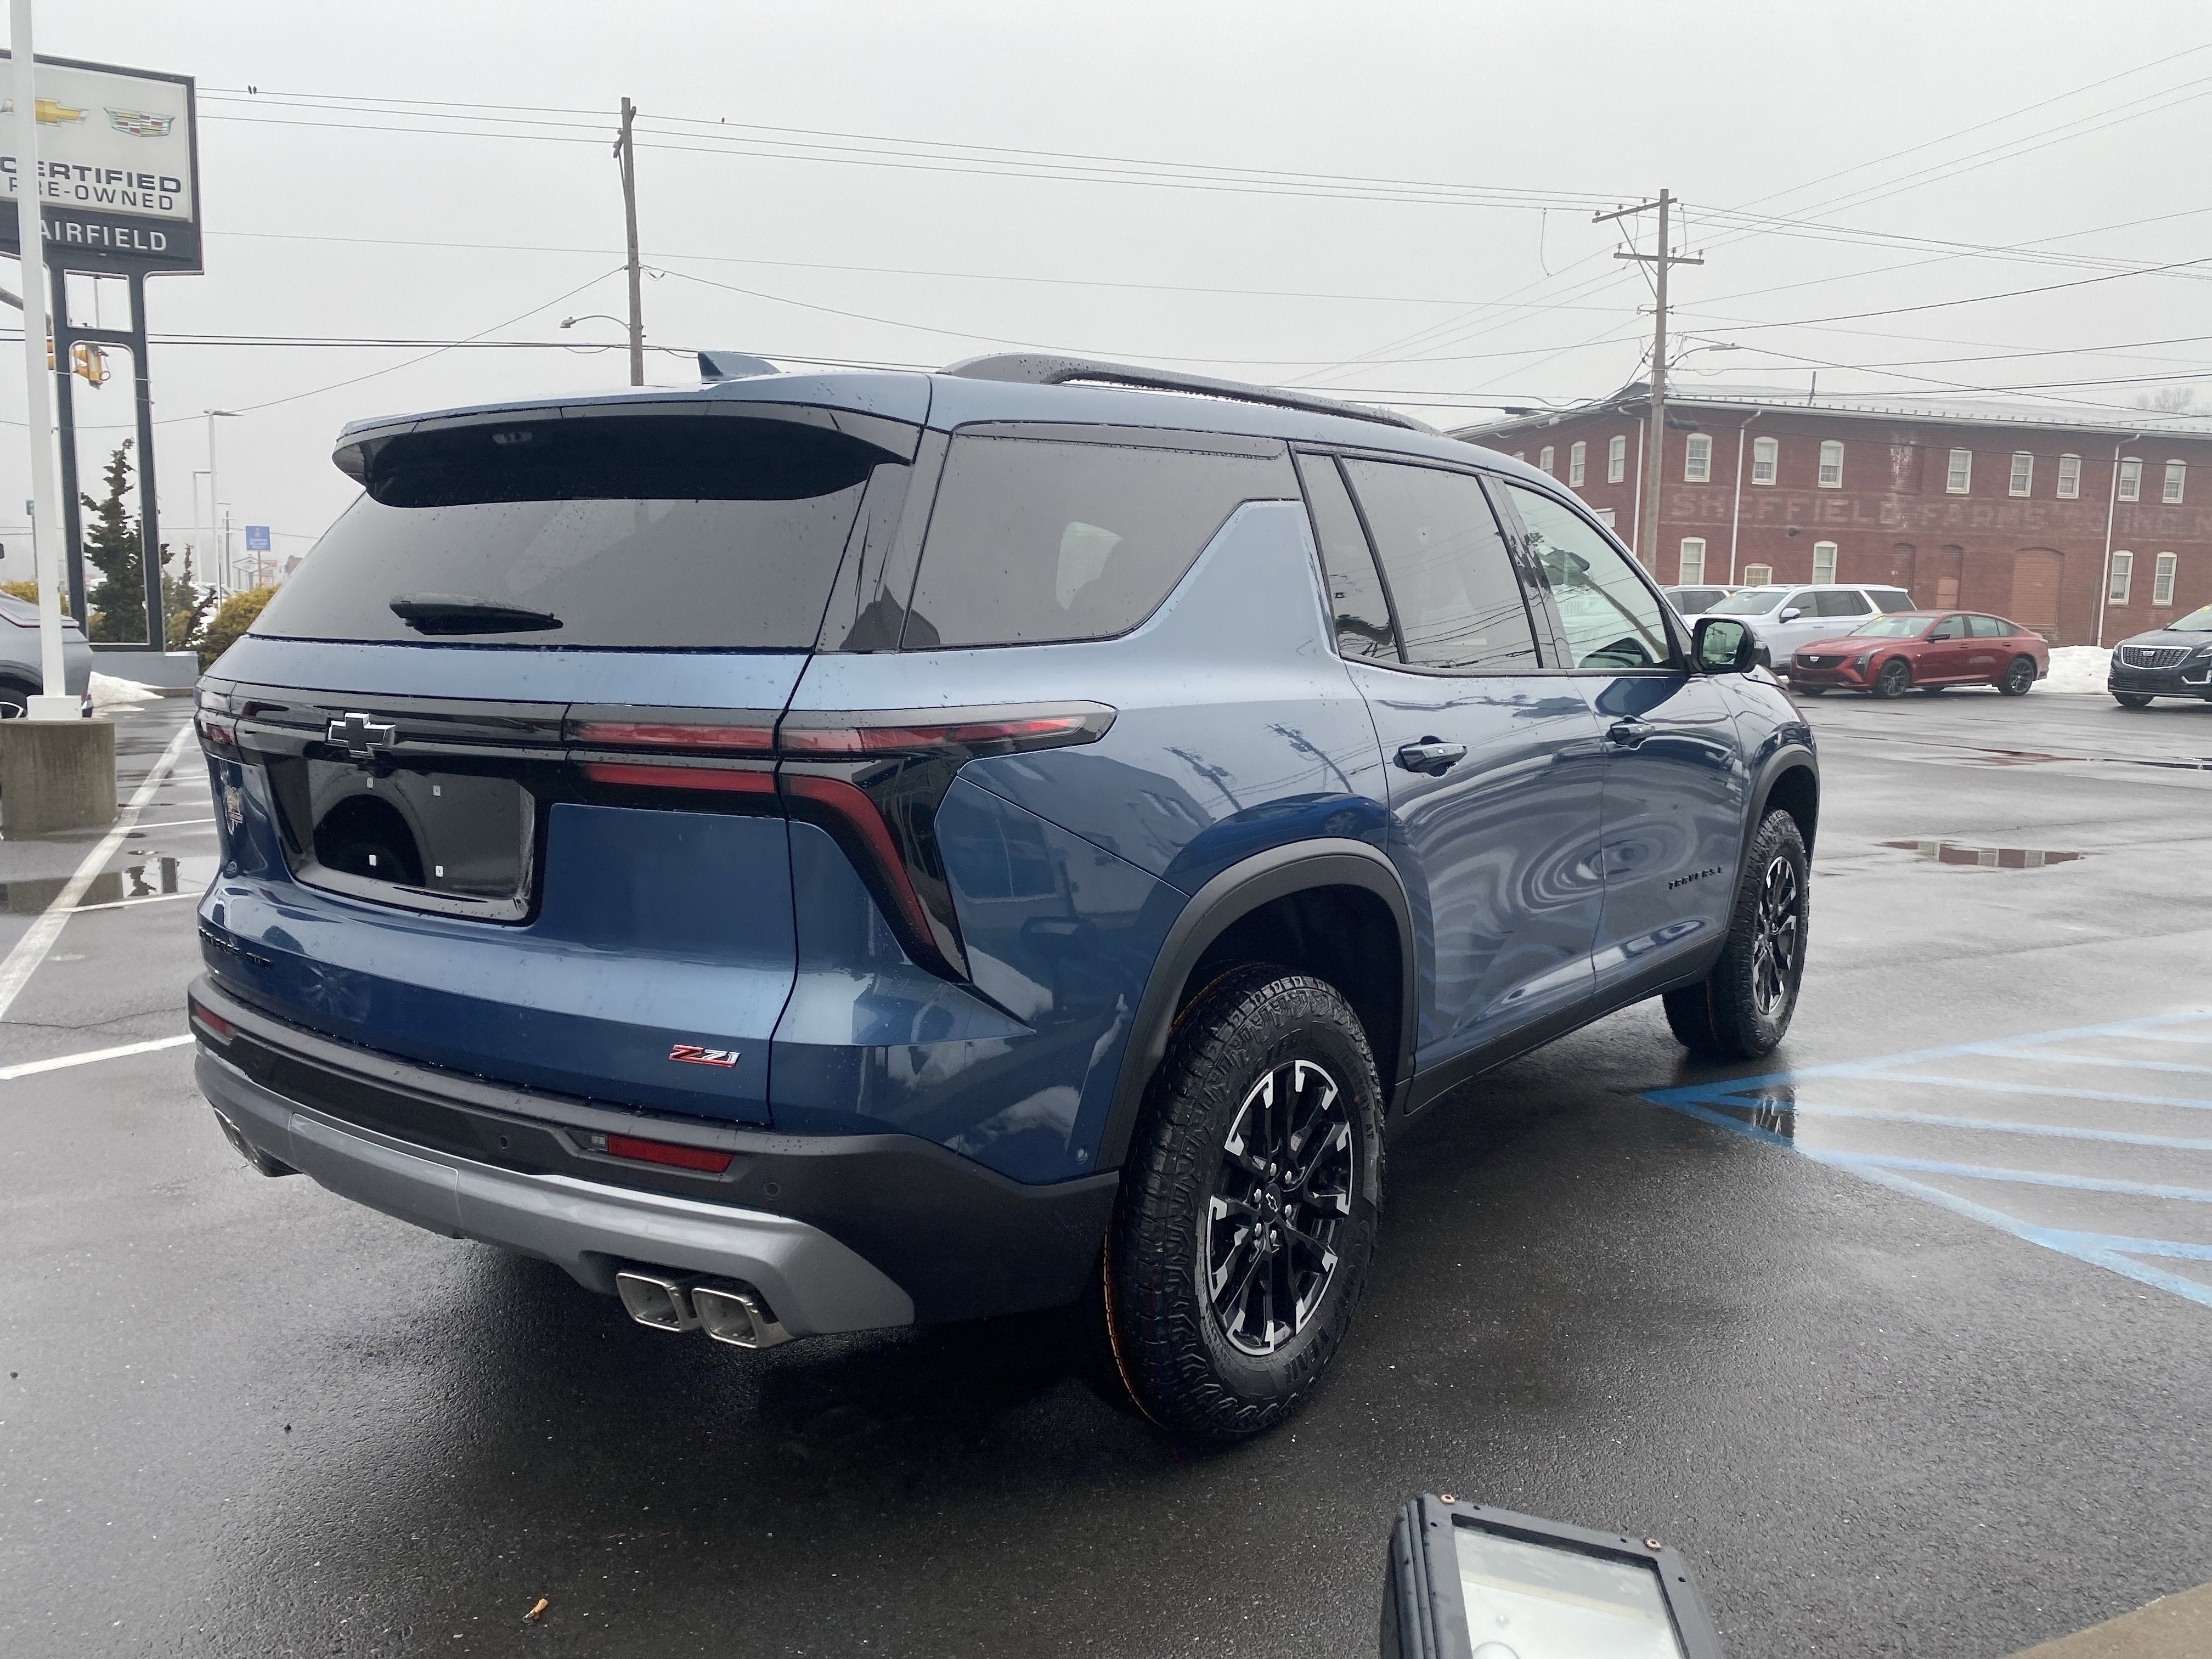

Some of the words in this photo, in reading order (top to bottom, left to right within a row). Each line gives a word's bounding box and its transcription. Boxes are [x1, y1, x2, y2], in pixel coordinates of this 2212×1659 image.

[9, 177, 173, 210] PE-OWNED
[1671, 492, 1901, 525] SHEFFIELD
[668, 1043, 742, 1068] Z71
